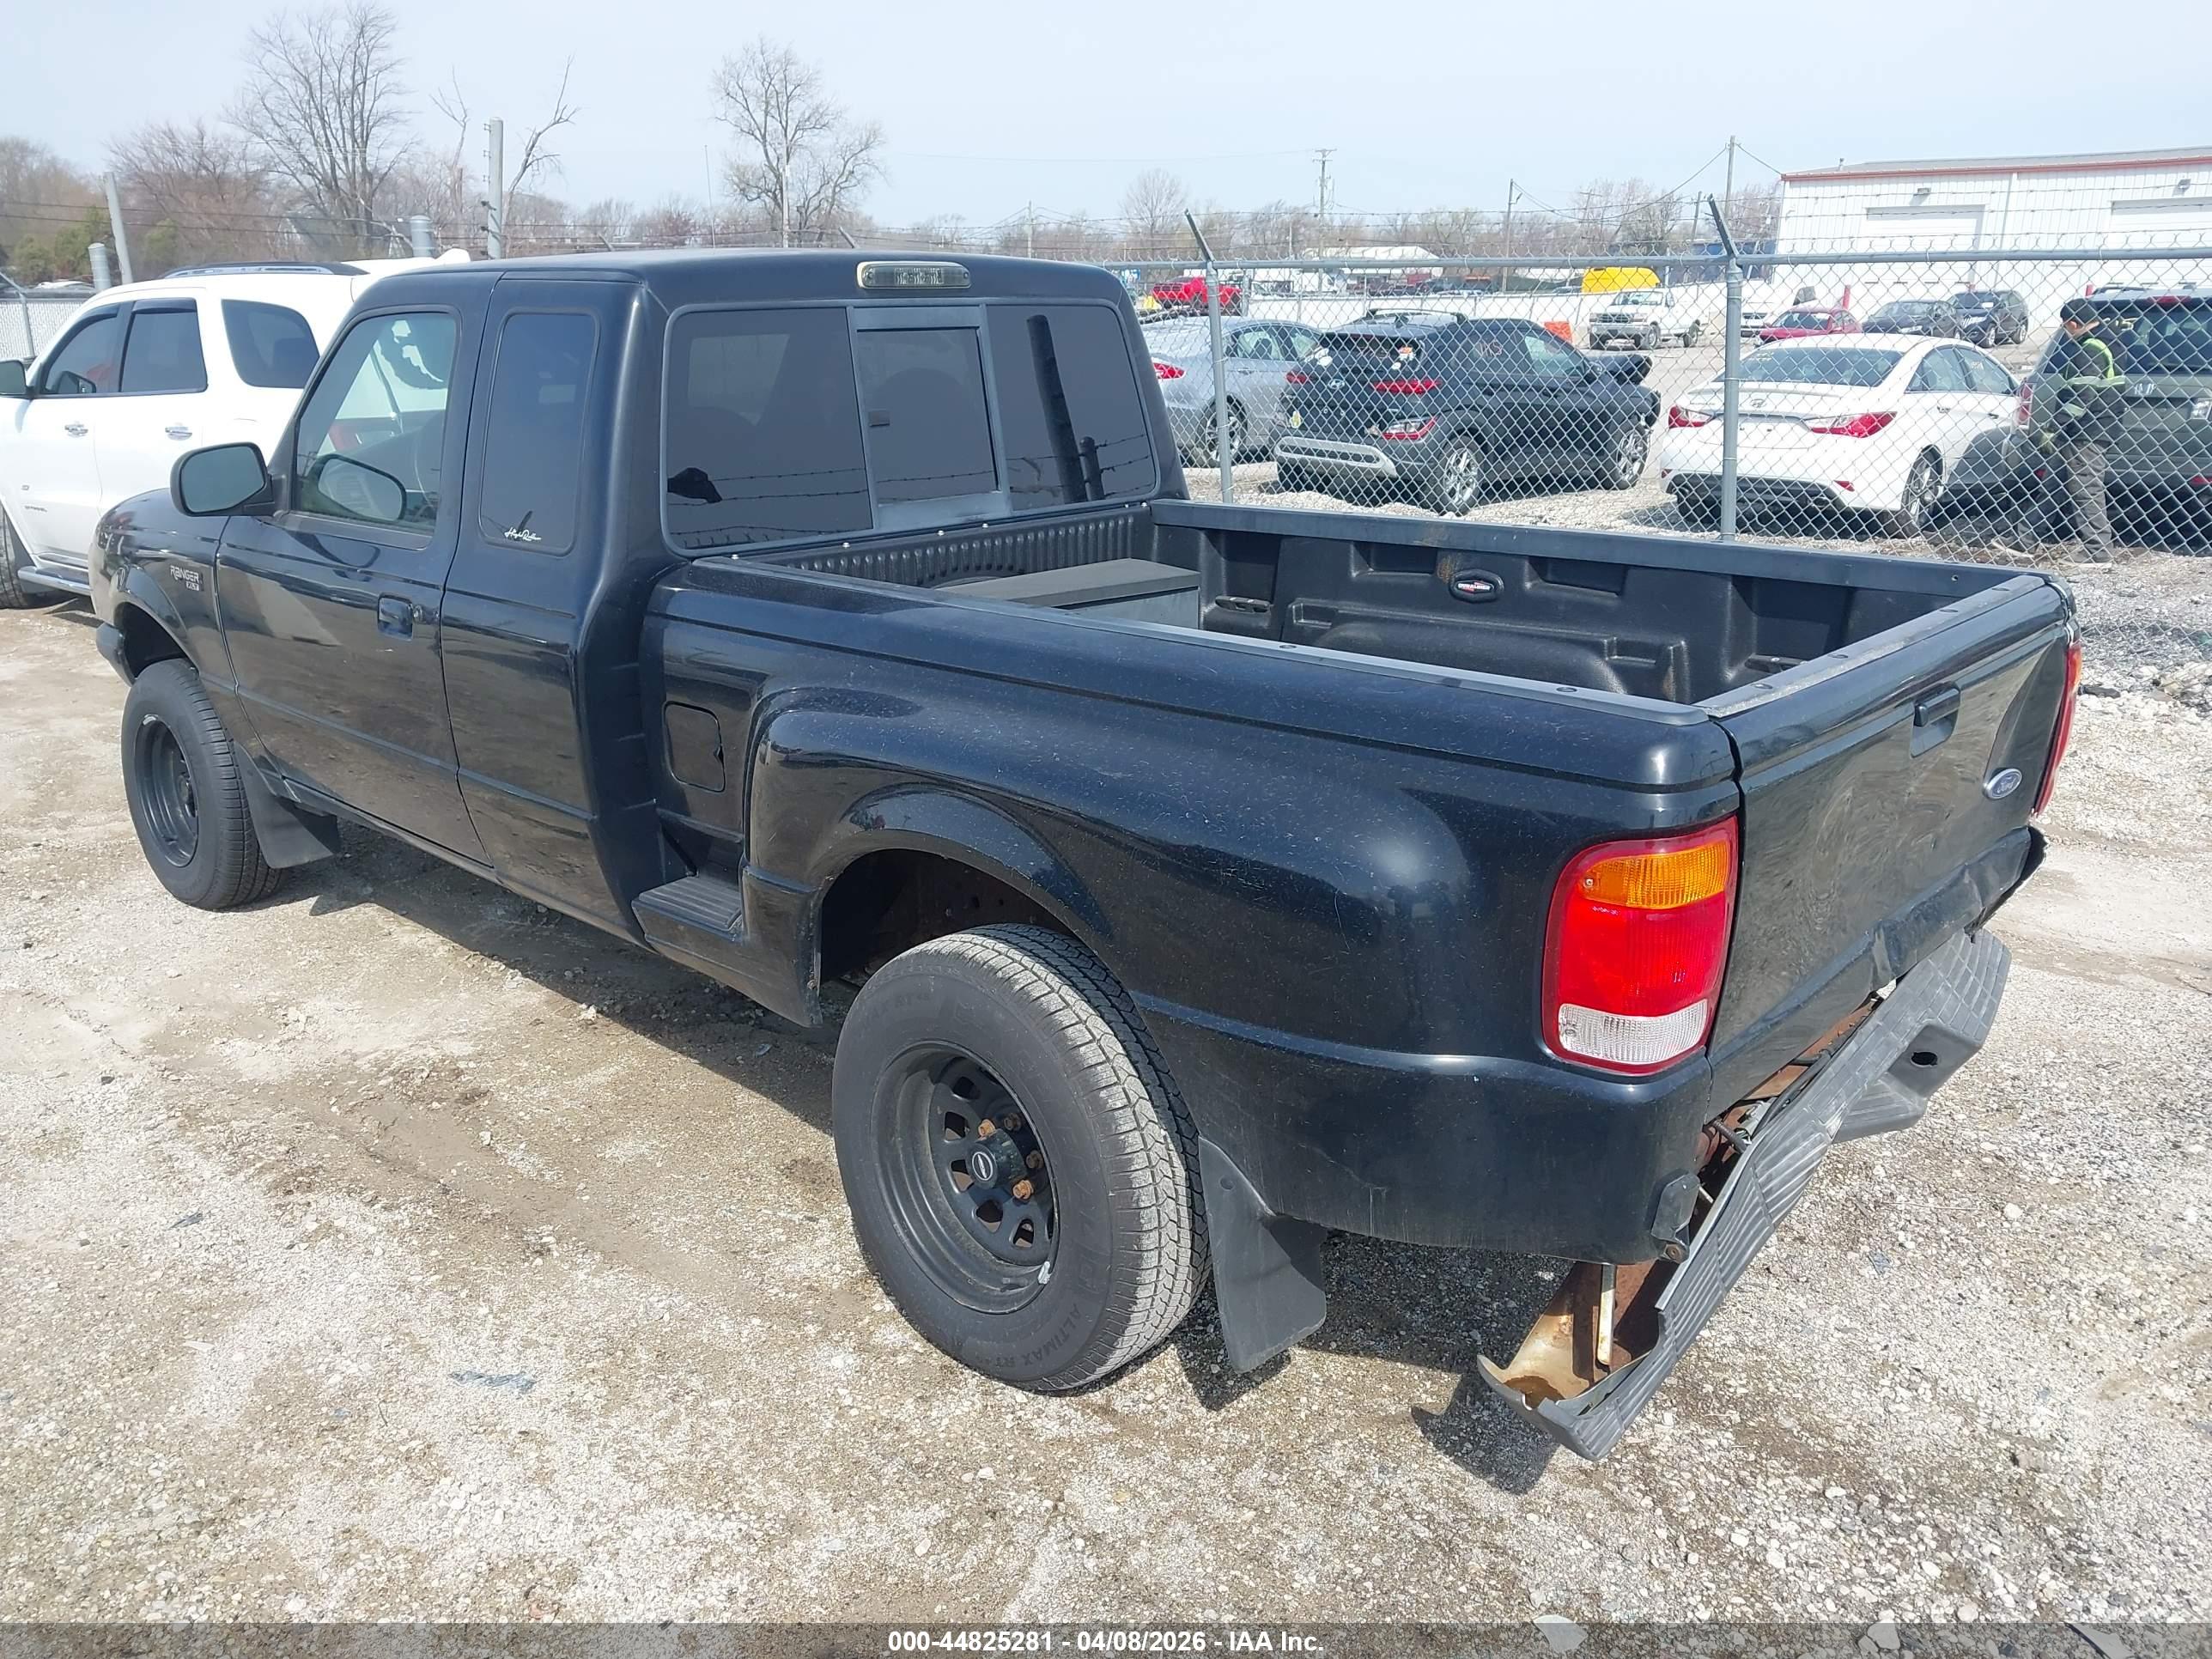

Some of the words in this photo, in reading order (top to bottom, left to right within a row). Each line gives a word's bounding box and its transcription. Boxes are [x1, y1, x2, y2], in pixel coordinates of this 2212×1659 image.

[170, 565, 200, 583] RANGER
[1996, 775, 2018, 794] Ford
[1020, 1303, 1081, 1367] ALTIMAX
